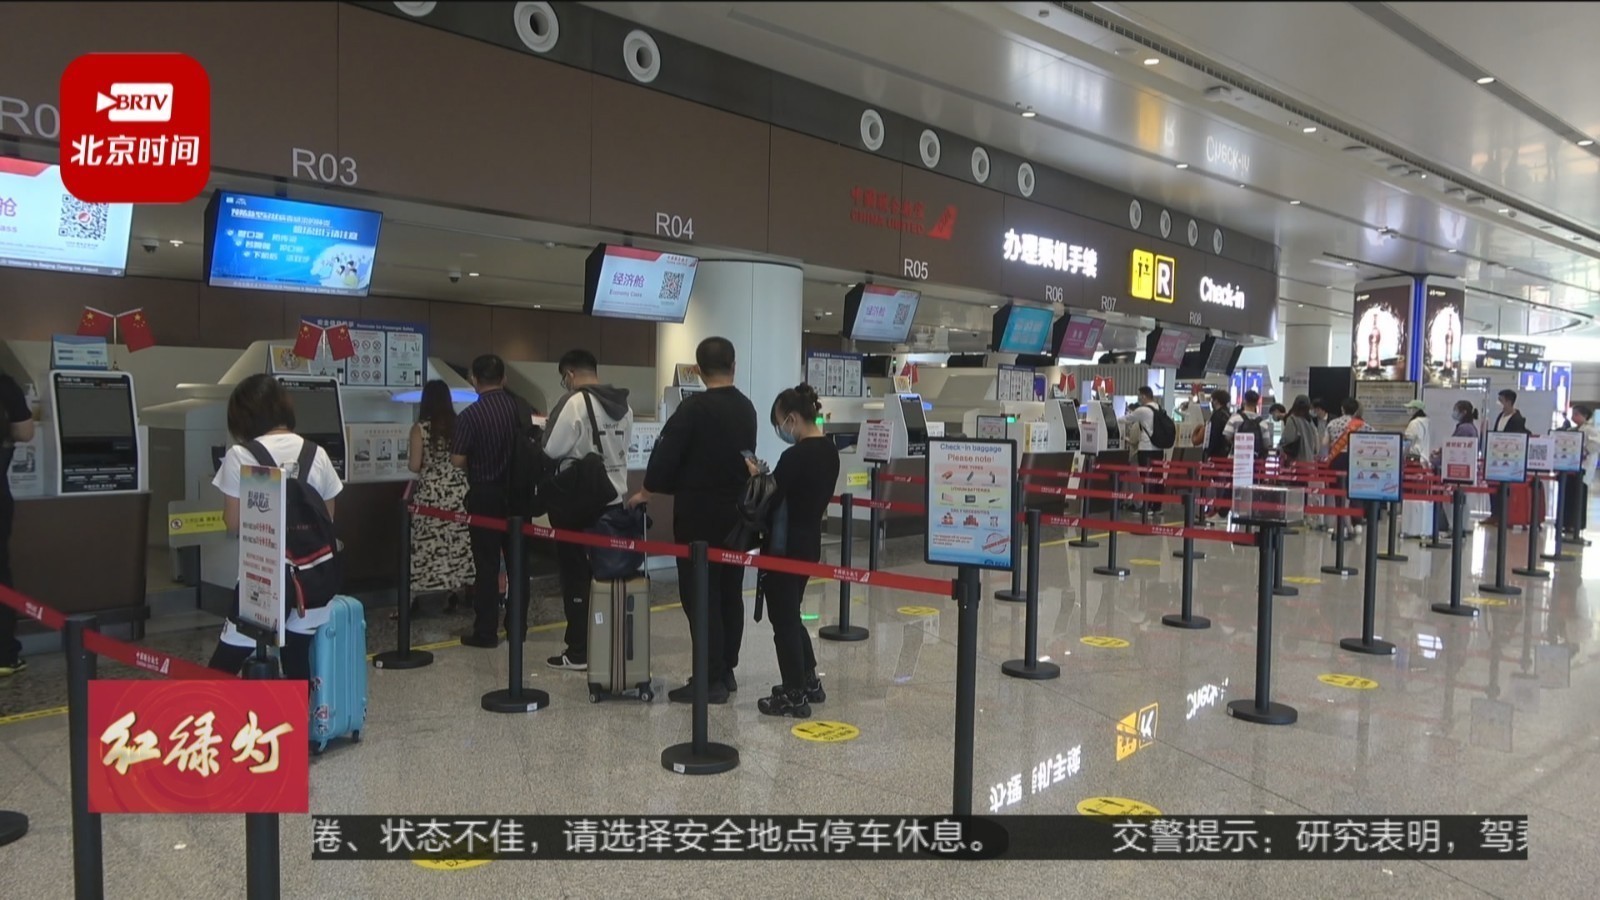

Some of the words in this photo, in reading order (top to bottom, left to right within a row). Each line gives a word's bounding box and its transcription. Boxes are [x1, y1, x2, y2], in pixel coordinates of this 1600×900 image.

[291, 147, 358, 185] R03
[656, 212, 694, 240] R04
[1003, 228, 1098, 279] 办理乘机手续
[612, 271, 645, 288] 经济舱
[904, 258, 929, 280] R05
[1157, 262, 1170, 296] R
[1045, 285, 1064, 302] R06
[1101, 296, 1117, 311] R07
[1200, 276, 1245, 310] Check-in
[972, 444, 1002, 453] baggage
